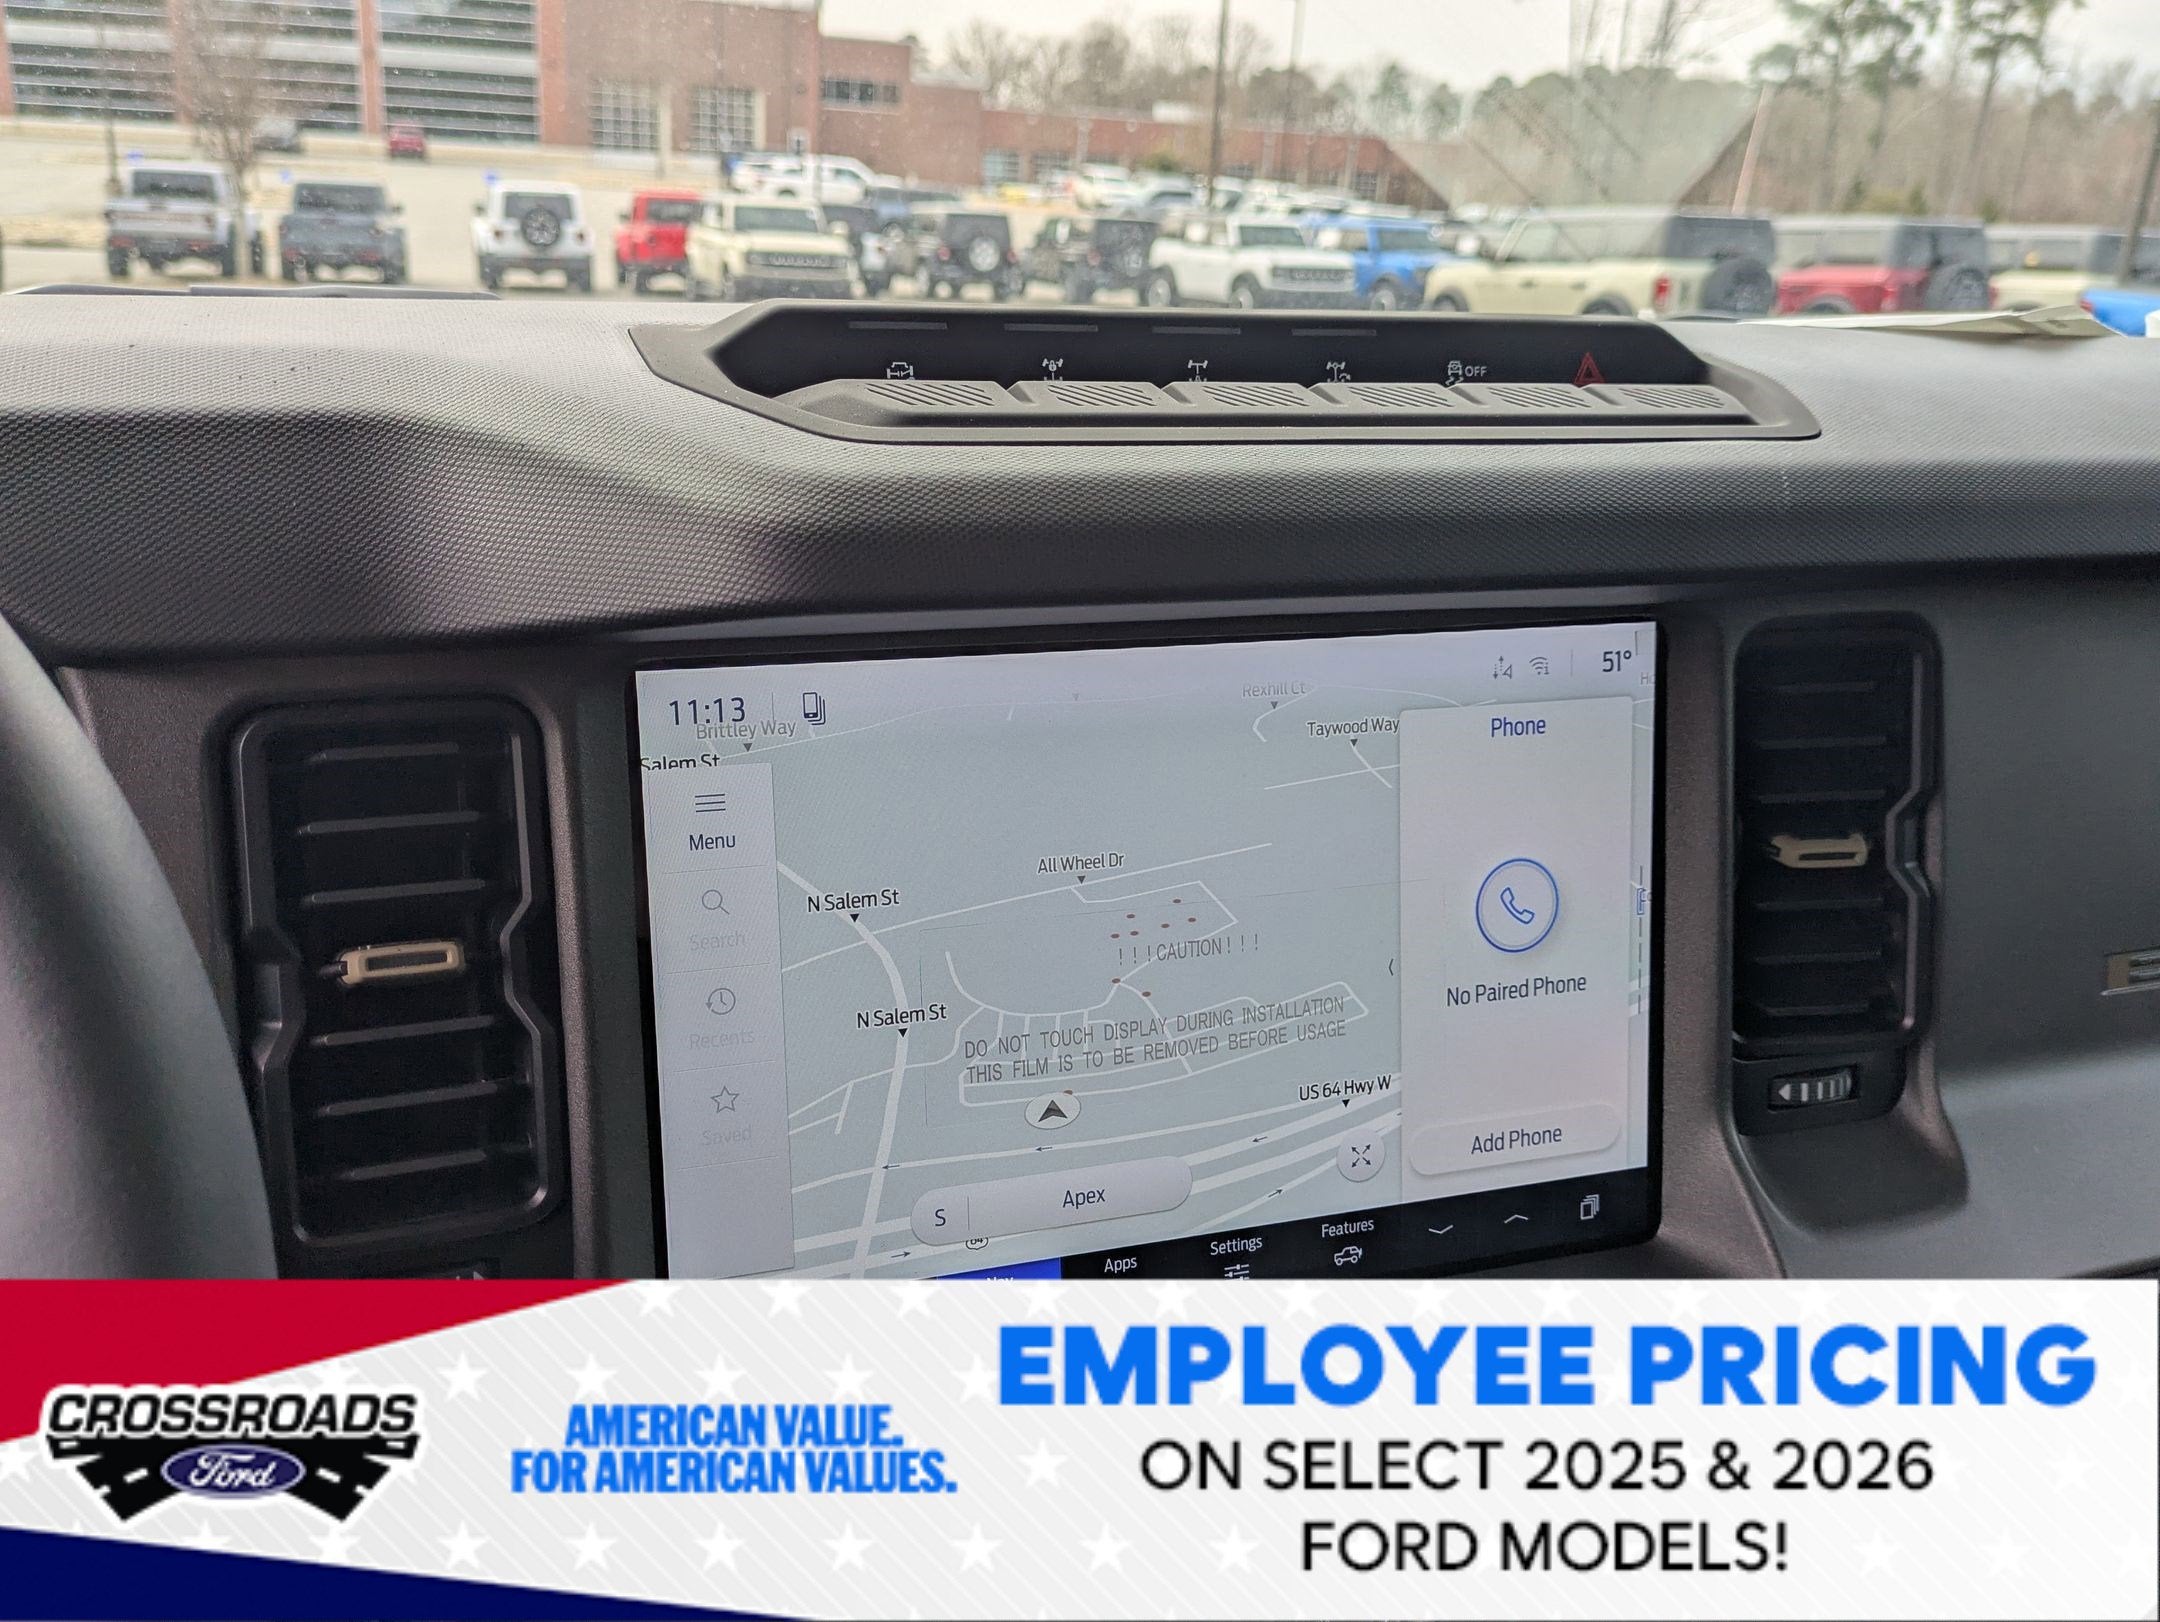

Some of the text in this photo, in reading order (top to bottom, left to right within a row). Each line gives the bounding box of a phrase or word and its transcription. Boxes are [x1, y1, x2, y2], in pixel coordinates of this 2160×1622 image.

[1464, 365, 1488, 377] OFF
[1242, 681, 1306, 698] Rexhill Ct
[669, 696, 746, 726] 11:13
[697, 720, 796, 741] Brittley Way
[1307, 717, 1400, 737] Taywood Way
[1491, 716, 1547, 738] Phone
[688, 832, 736, 851] Menu
[1037, 852, 1125, 873] All Wheel Dr
[807, 889, 899, 913] N Salem St
[689, 931, 746, 950] Search
[1446, 974, 1587, 1007] No Paired Phone
[857, 1003, 947, 1028] N Salem St
[964, 996, 1344, 1059] DO NOT TOUCH DISPLAY DURING INSTALLATION
[690, 1030, 756, 1049] Recents
[966, 1019, 1346, 1084] THIS FILM IS TO BE REMOVED BEFORE USAGE
[1299, 1074, 1391, 1100] US 64 Hwy W
[702, 1127, 752, 1147] Saved
[1471, 1124, 1562, 1155] Add Phone
[1062, 1186, 1106, 1210] Apex
[934, 1208, 946, 1227] S
[1321, 1217, 1374, 1238] Features
[1210, 1234, 1263, 1256] Settings
[1104, 1256, 1138, 1274] Apps
